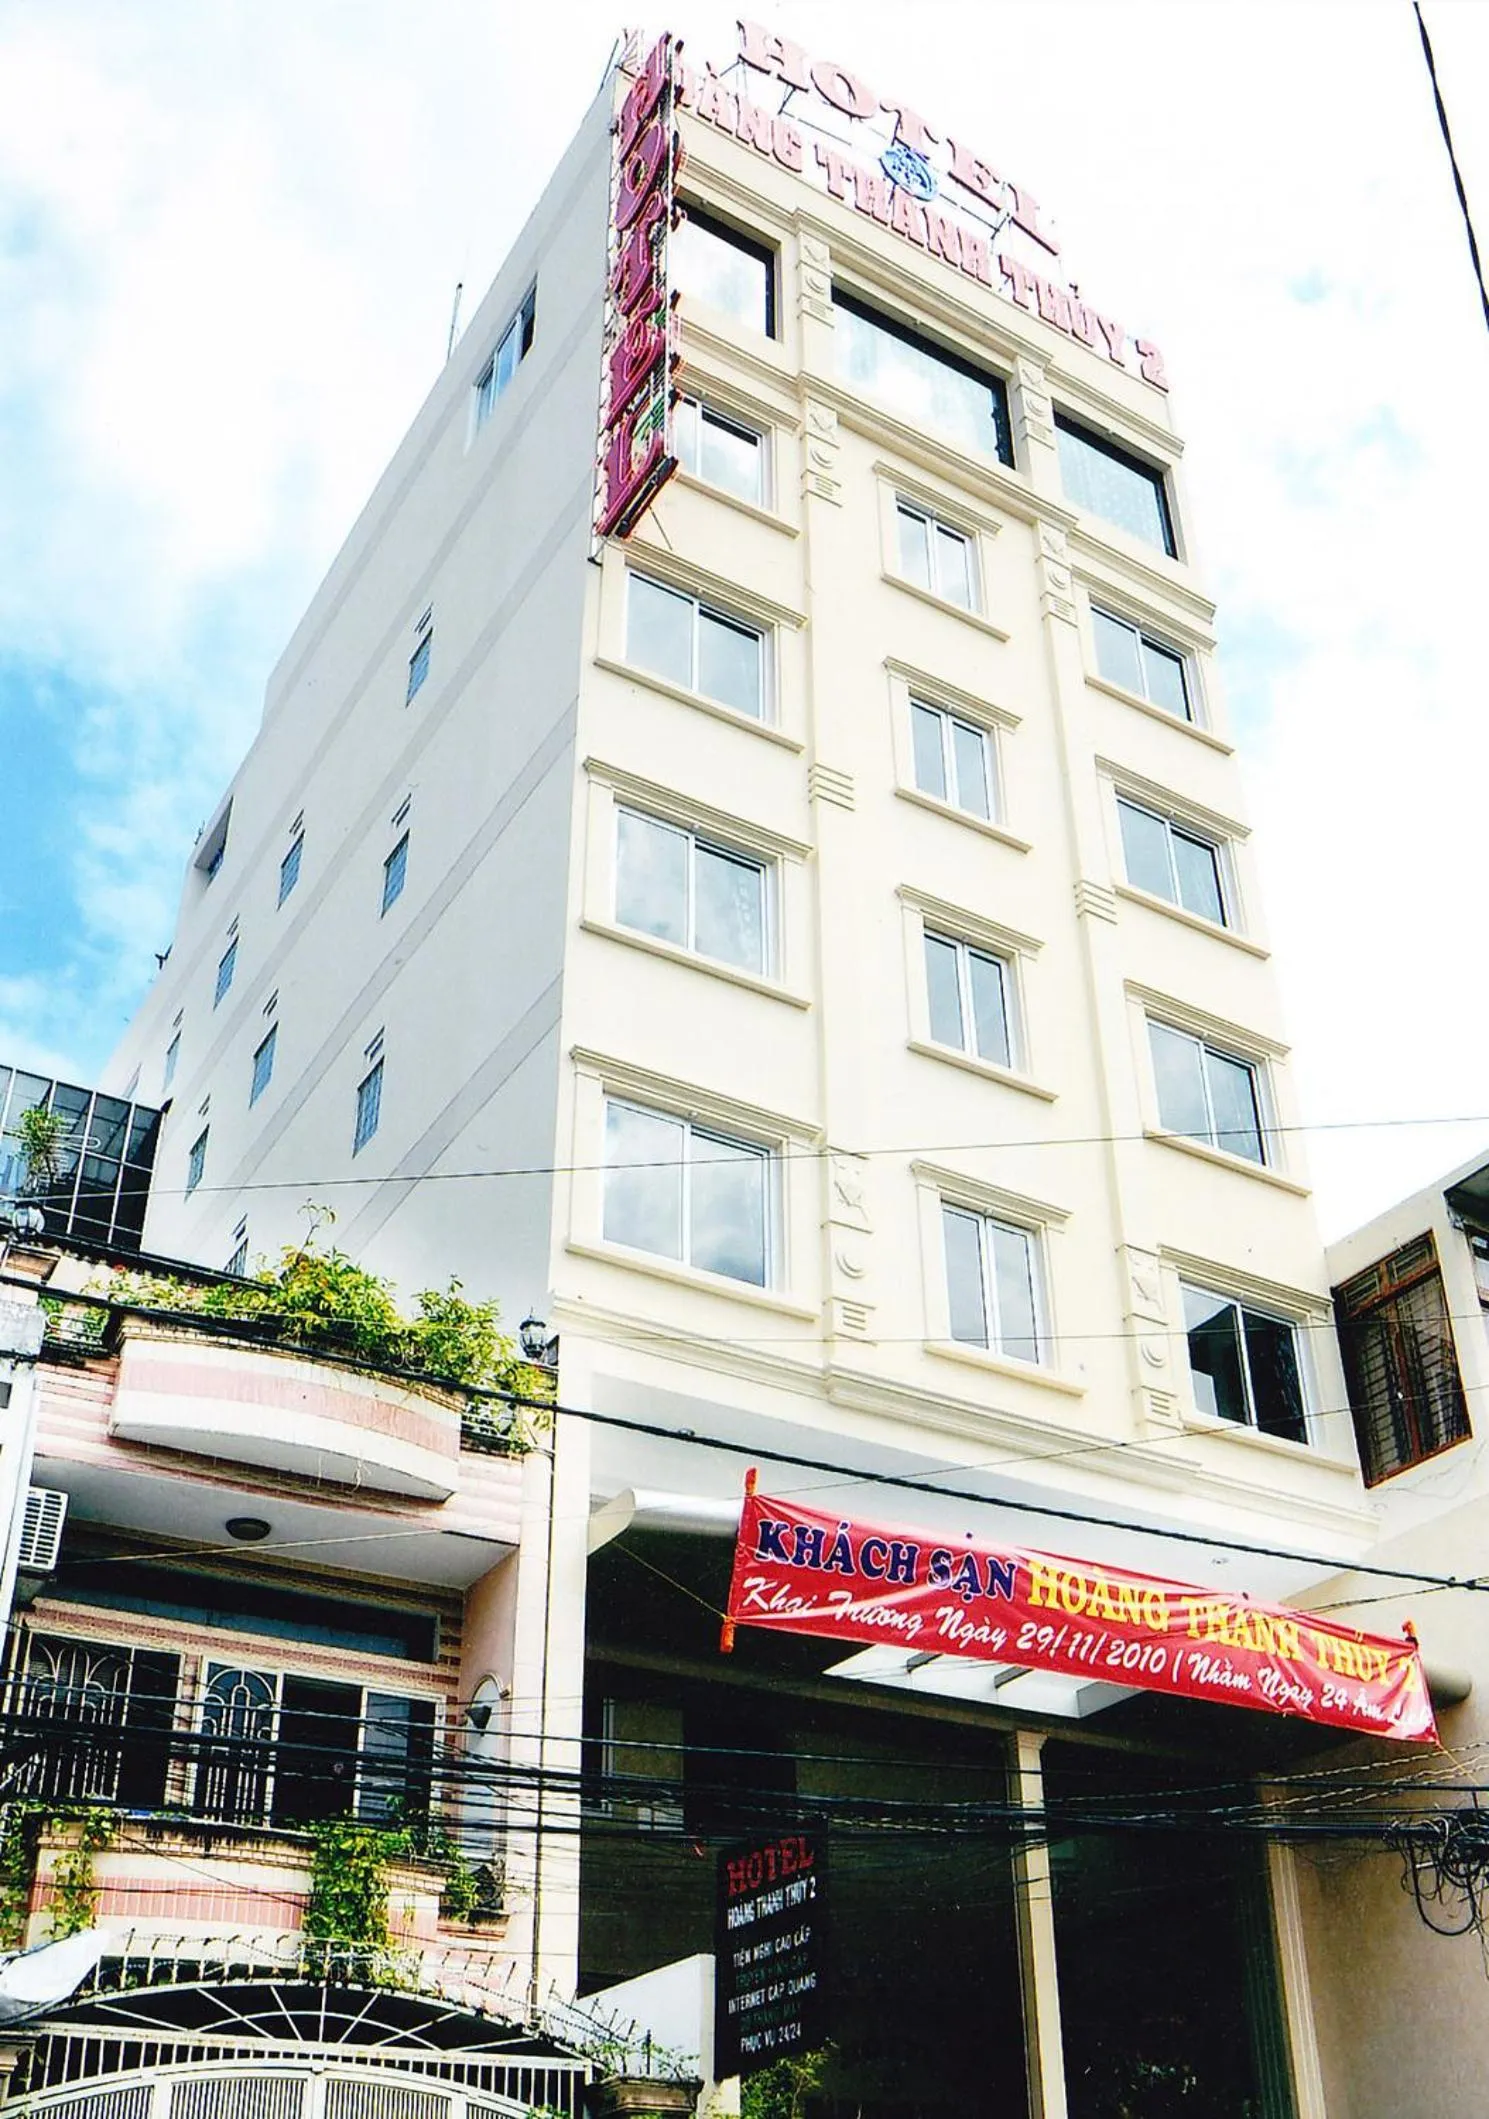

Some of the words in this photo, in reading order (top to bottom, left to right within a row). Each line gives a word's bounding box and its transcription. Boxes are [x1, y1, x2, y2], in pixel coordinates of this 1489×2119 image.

[736, 19, 1060, 256] HOTEL
[814, 143, 992, 288] THANH
[1134, 338, 1170, 393] 2
[742, 1576, 817, 1614] Khai
[935, 1606, 1007, 1653] Ngày
[1320, 1683, 1348, 1712] 24
[754, 1520, 921, 1584] KHÁCH
[927, 1548, 1016, 1603] SẠN
[1027, 1561, 1169, 1632] HOÀNG
[1180, 1596, 1304, 1662] THANH
[1397, 1656, 1420, 1692] 2
[727, 1836, 814, 1896] HOTEL
[756, 1888, 784, 1919] THANH
[808, 1876, 817, 1899] 2
[728, 1988, 766, 2015] INTERNET
[788, 1971, 817, 1996] QUANG
[775, 1934, 792, 1954] CAO
